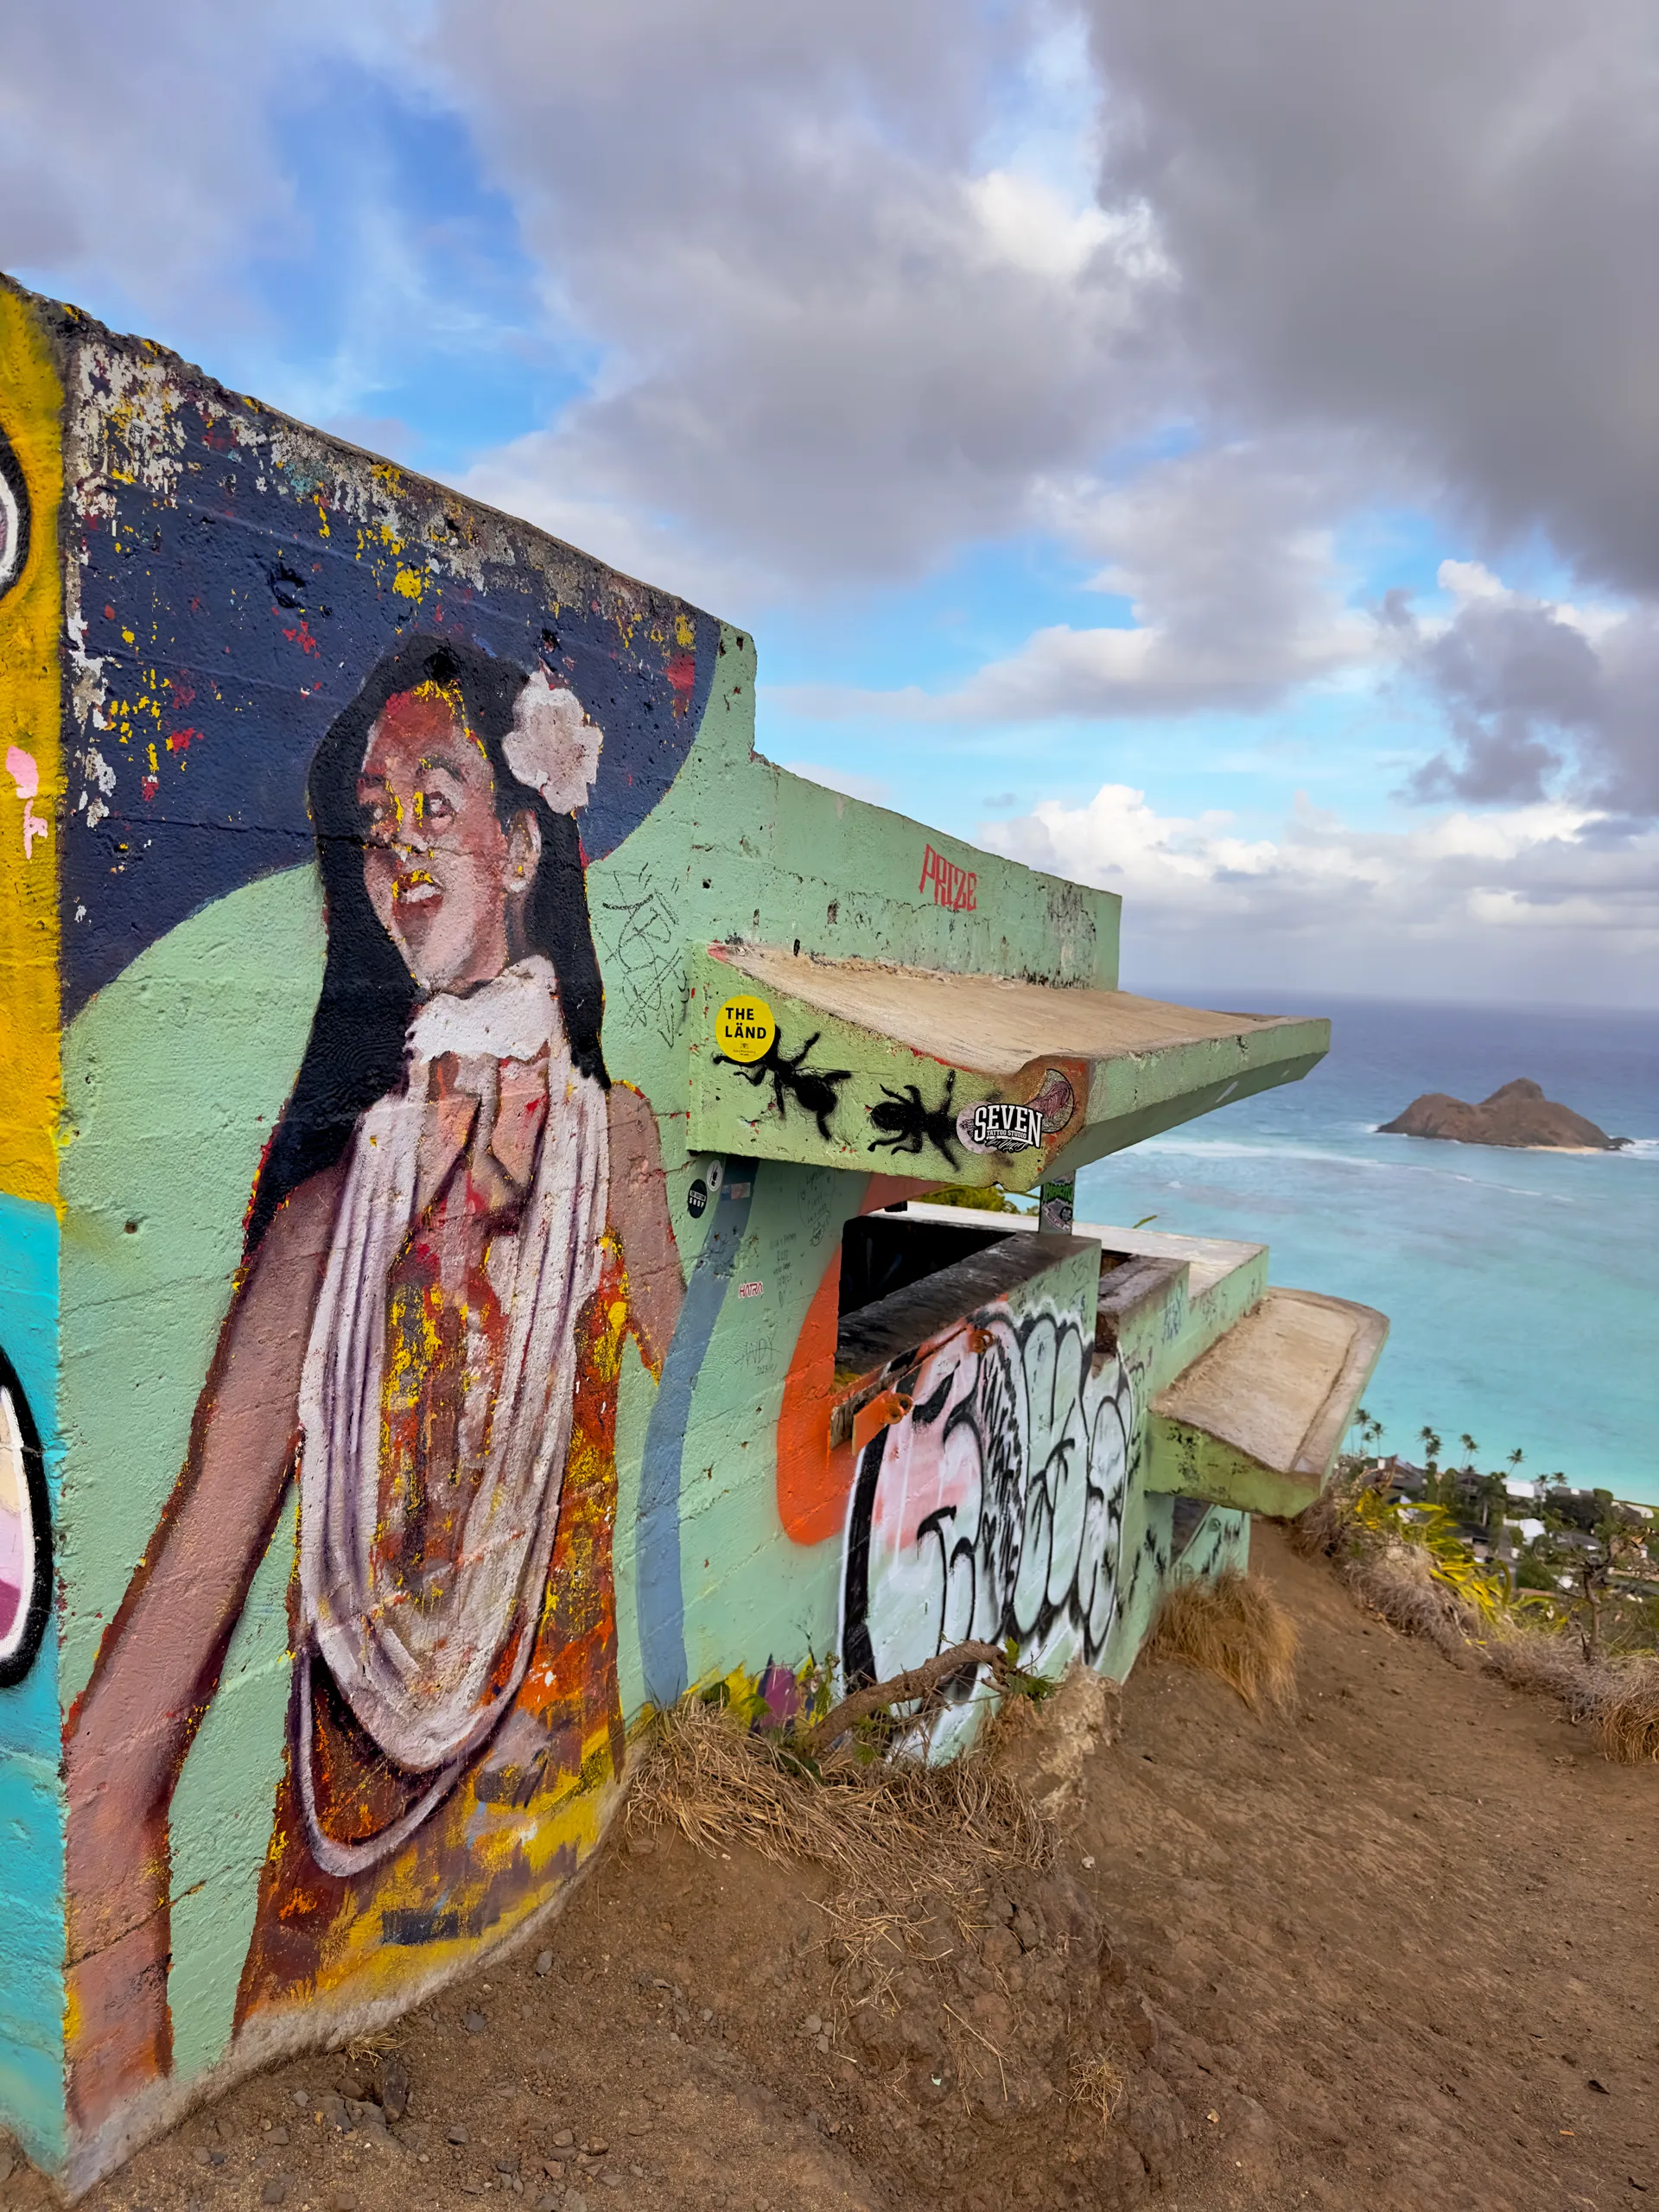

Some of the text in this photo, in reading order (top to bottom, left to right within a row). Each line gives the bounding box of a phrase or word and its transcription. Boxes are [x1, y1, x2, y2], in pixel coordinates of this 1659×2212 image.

[918, 843, 976, 912] PRIZE
[725, 1007, 754, 1020] THE
[725, 1022, 766, 1039] LÄND
[974, 1105, 1043, 1148] SEVEN
[1007, 1129, 1027, 1139] STUDIO
[689, 1197, 704, 1208] SHOP
[739, 1281, 763, 1297] HATRA
